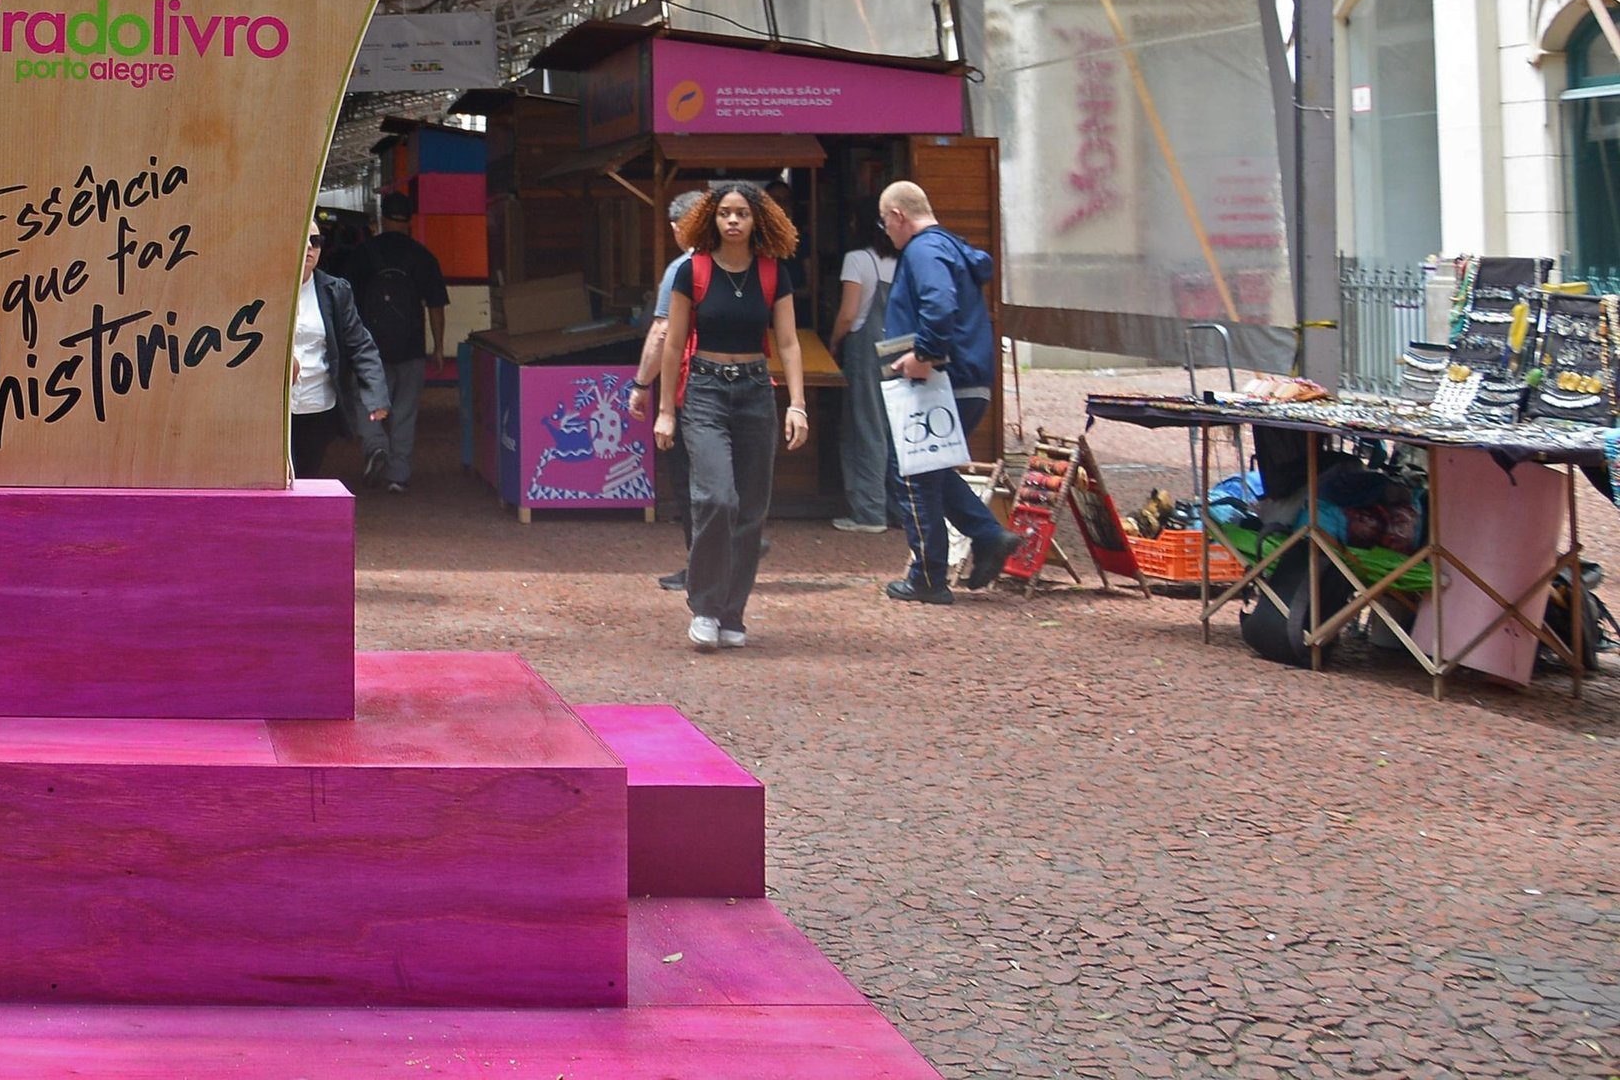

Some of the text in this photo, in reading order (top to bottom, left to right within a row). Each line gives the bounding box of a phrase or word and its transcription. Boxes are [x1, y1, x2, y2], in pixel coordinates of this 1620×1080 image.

[716, 85, 842, 96] AS PALAVRAS SÃO UM
[716, 98, 832, 108] FEITIÇO CARREGADO
[716, 108, 732, 117] DE
[2, 216, 199, 349] que faz
